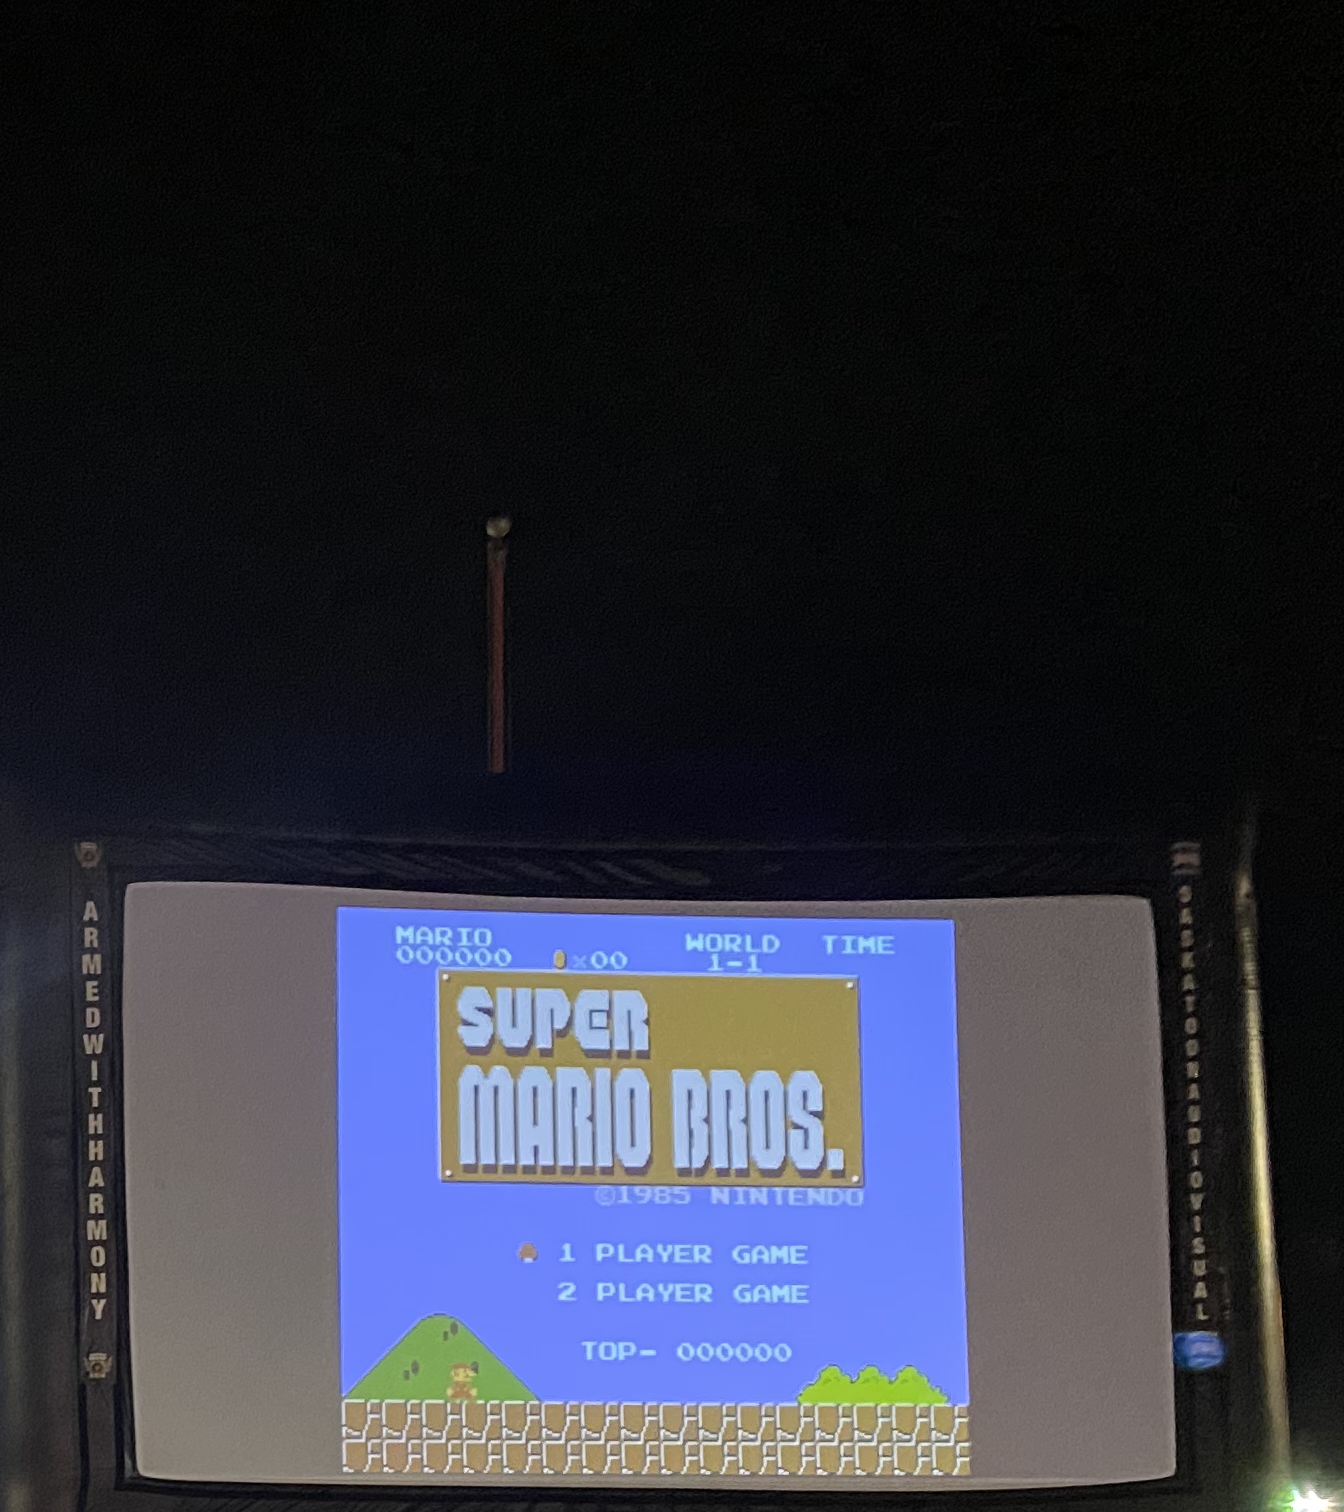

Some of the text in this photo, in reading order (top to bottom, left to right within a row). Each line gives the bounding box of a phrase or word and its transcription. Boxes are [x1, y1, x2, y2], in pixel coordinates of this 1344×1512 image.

[395, 926, 895, 955] MARIO WORLD TIME
[395, 947, 512, 967] 000000
[710, 954, 762, 972] 1-1
[457, 985, 650, 1053] SUPER
[458, 1064, 845, 1172] MARIO BROS.
[711, 1187, 864, 1206] NINTENDO
[558, 1242, 809, 1265] 1 PLAYER GAME
[557, 1282, 810, 1304] 2 PLAYER GAME
[581, 1341, 793, 1362] TOP- 000000
